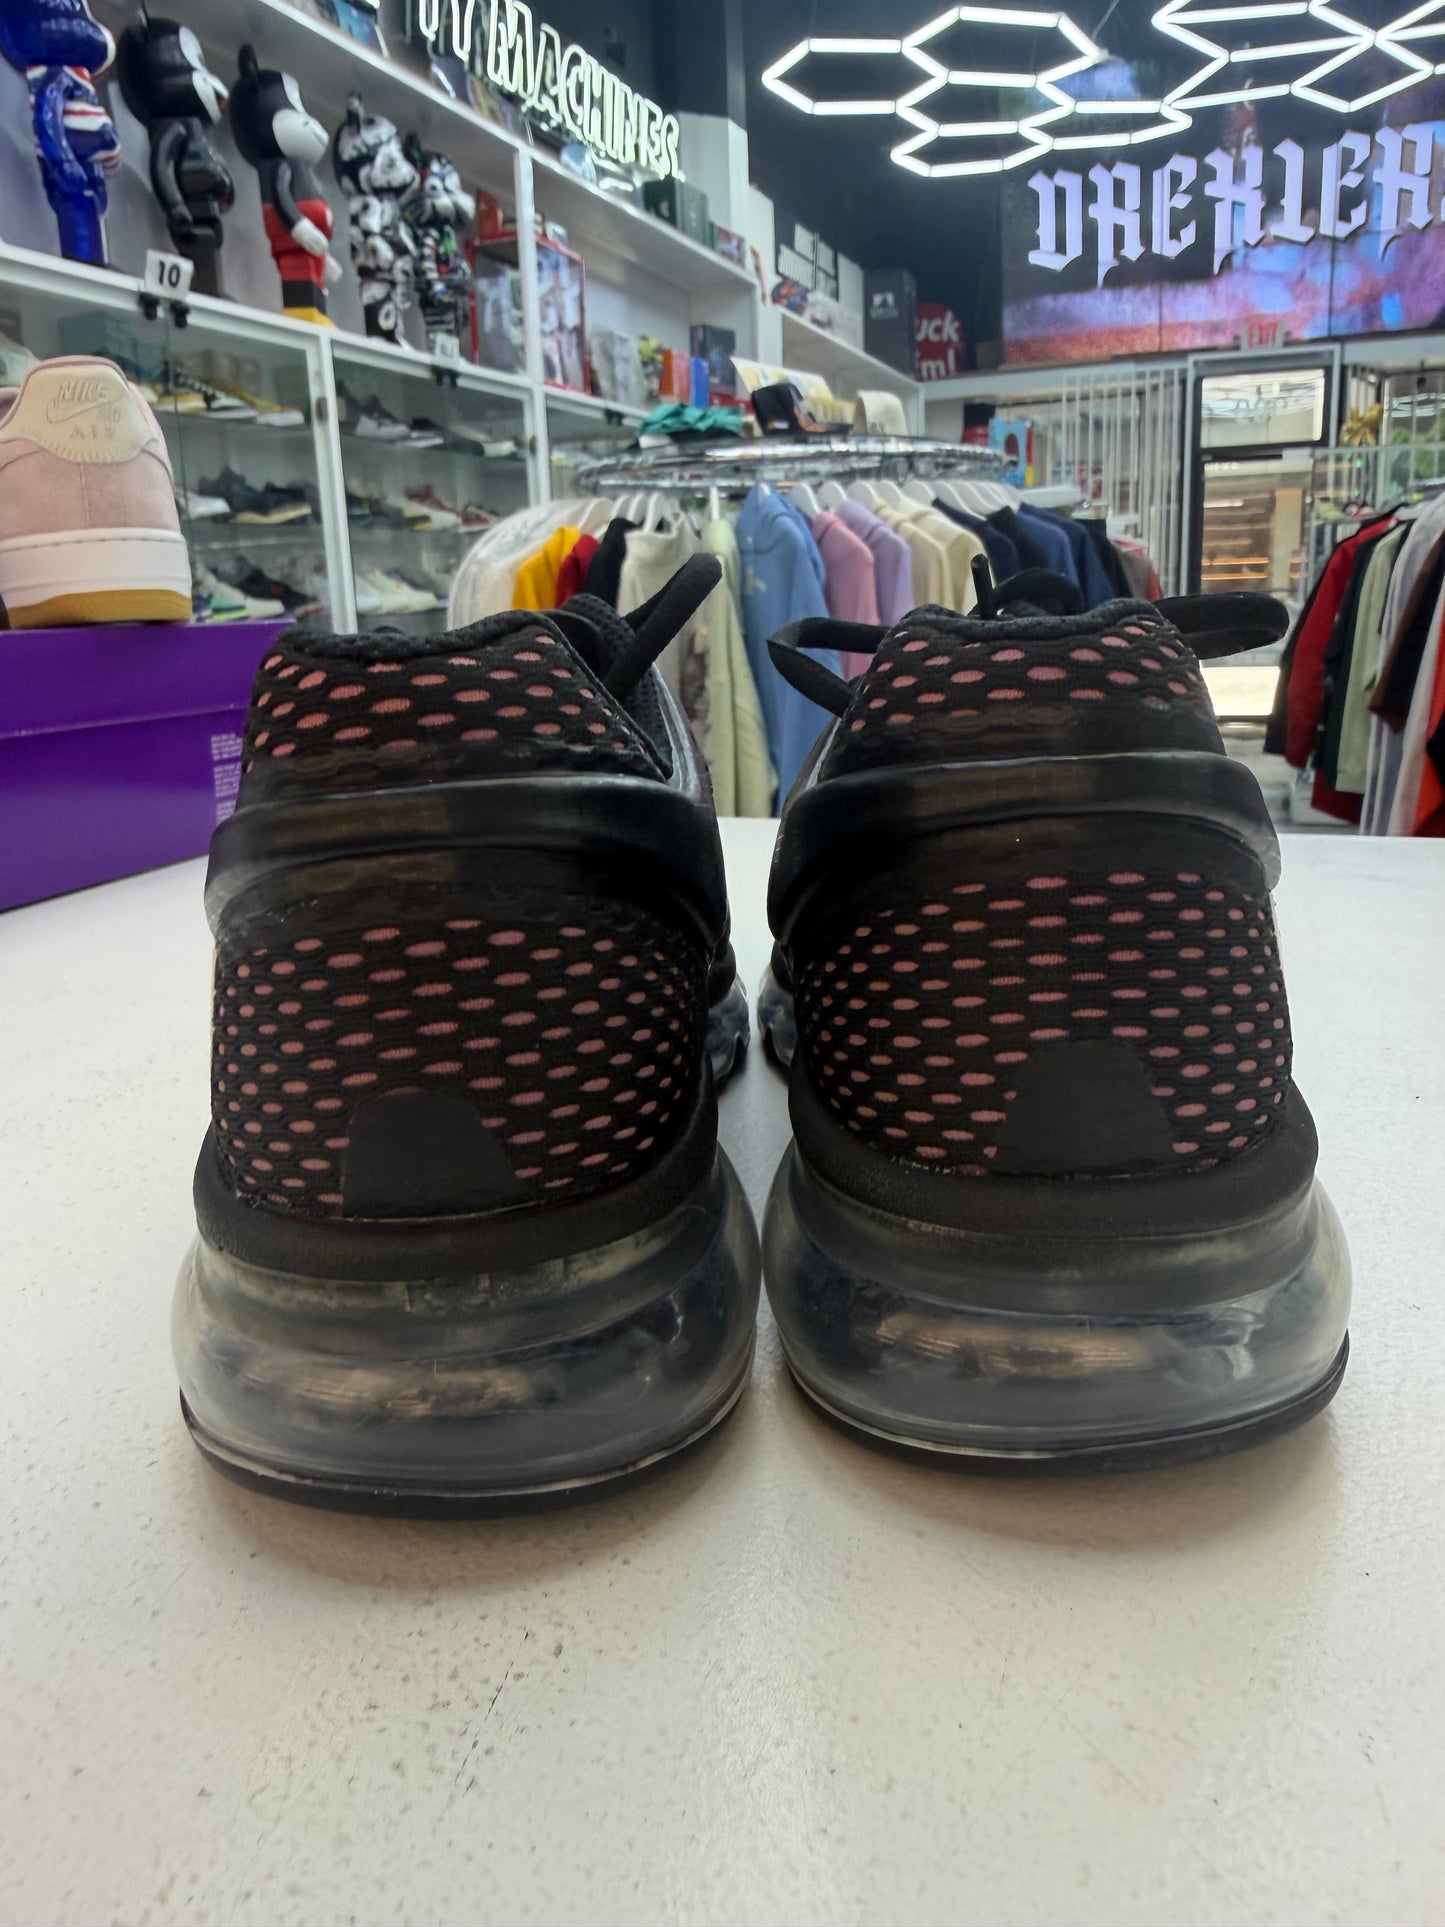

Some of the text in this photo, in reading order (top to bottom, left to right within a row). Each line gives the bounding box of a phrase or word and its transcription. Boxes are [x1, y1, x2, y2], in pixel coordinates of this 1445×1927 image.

[1028, 123, 1445, 289] DREXLER
[156, 260, 182, 289] 10
[915, 309, 960, 342] uck
[57, 383, 106, 402] NIKE
